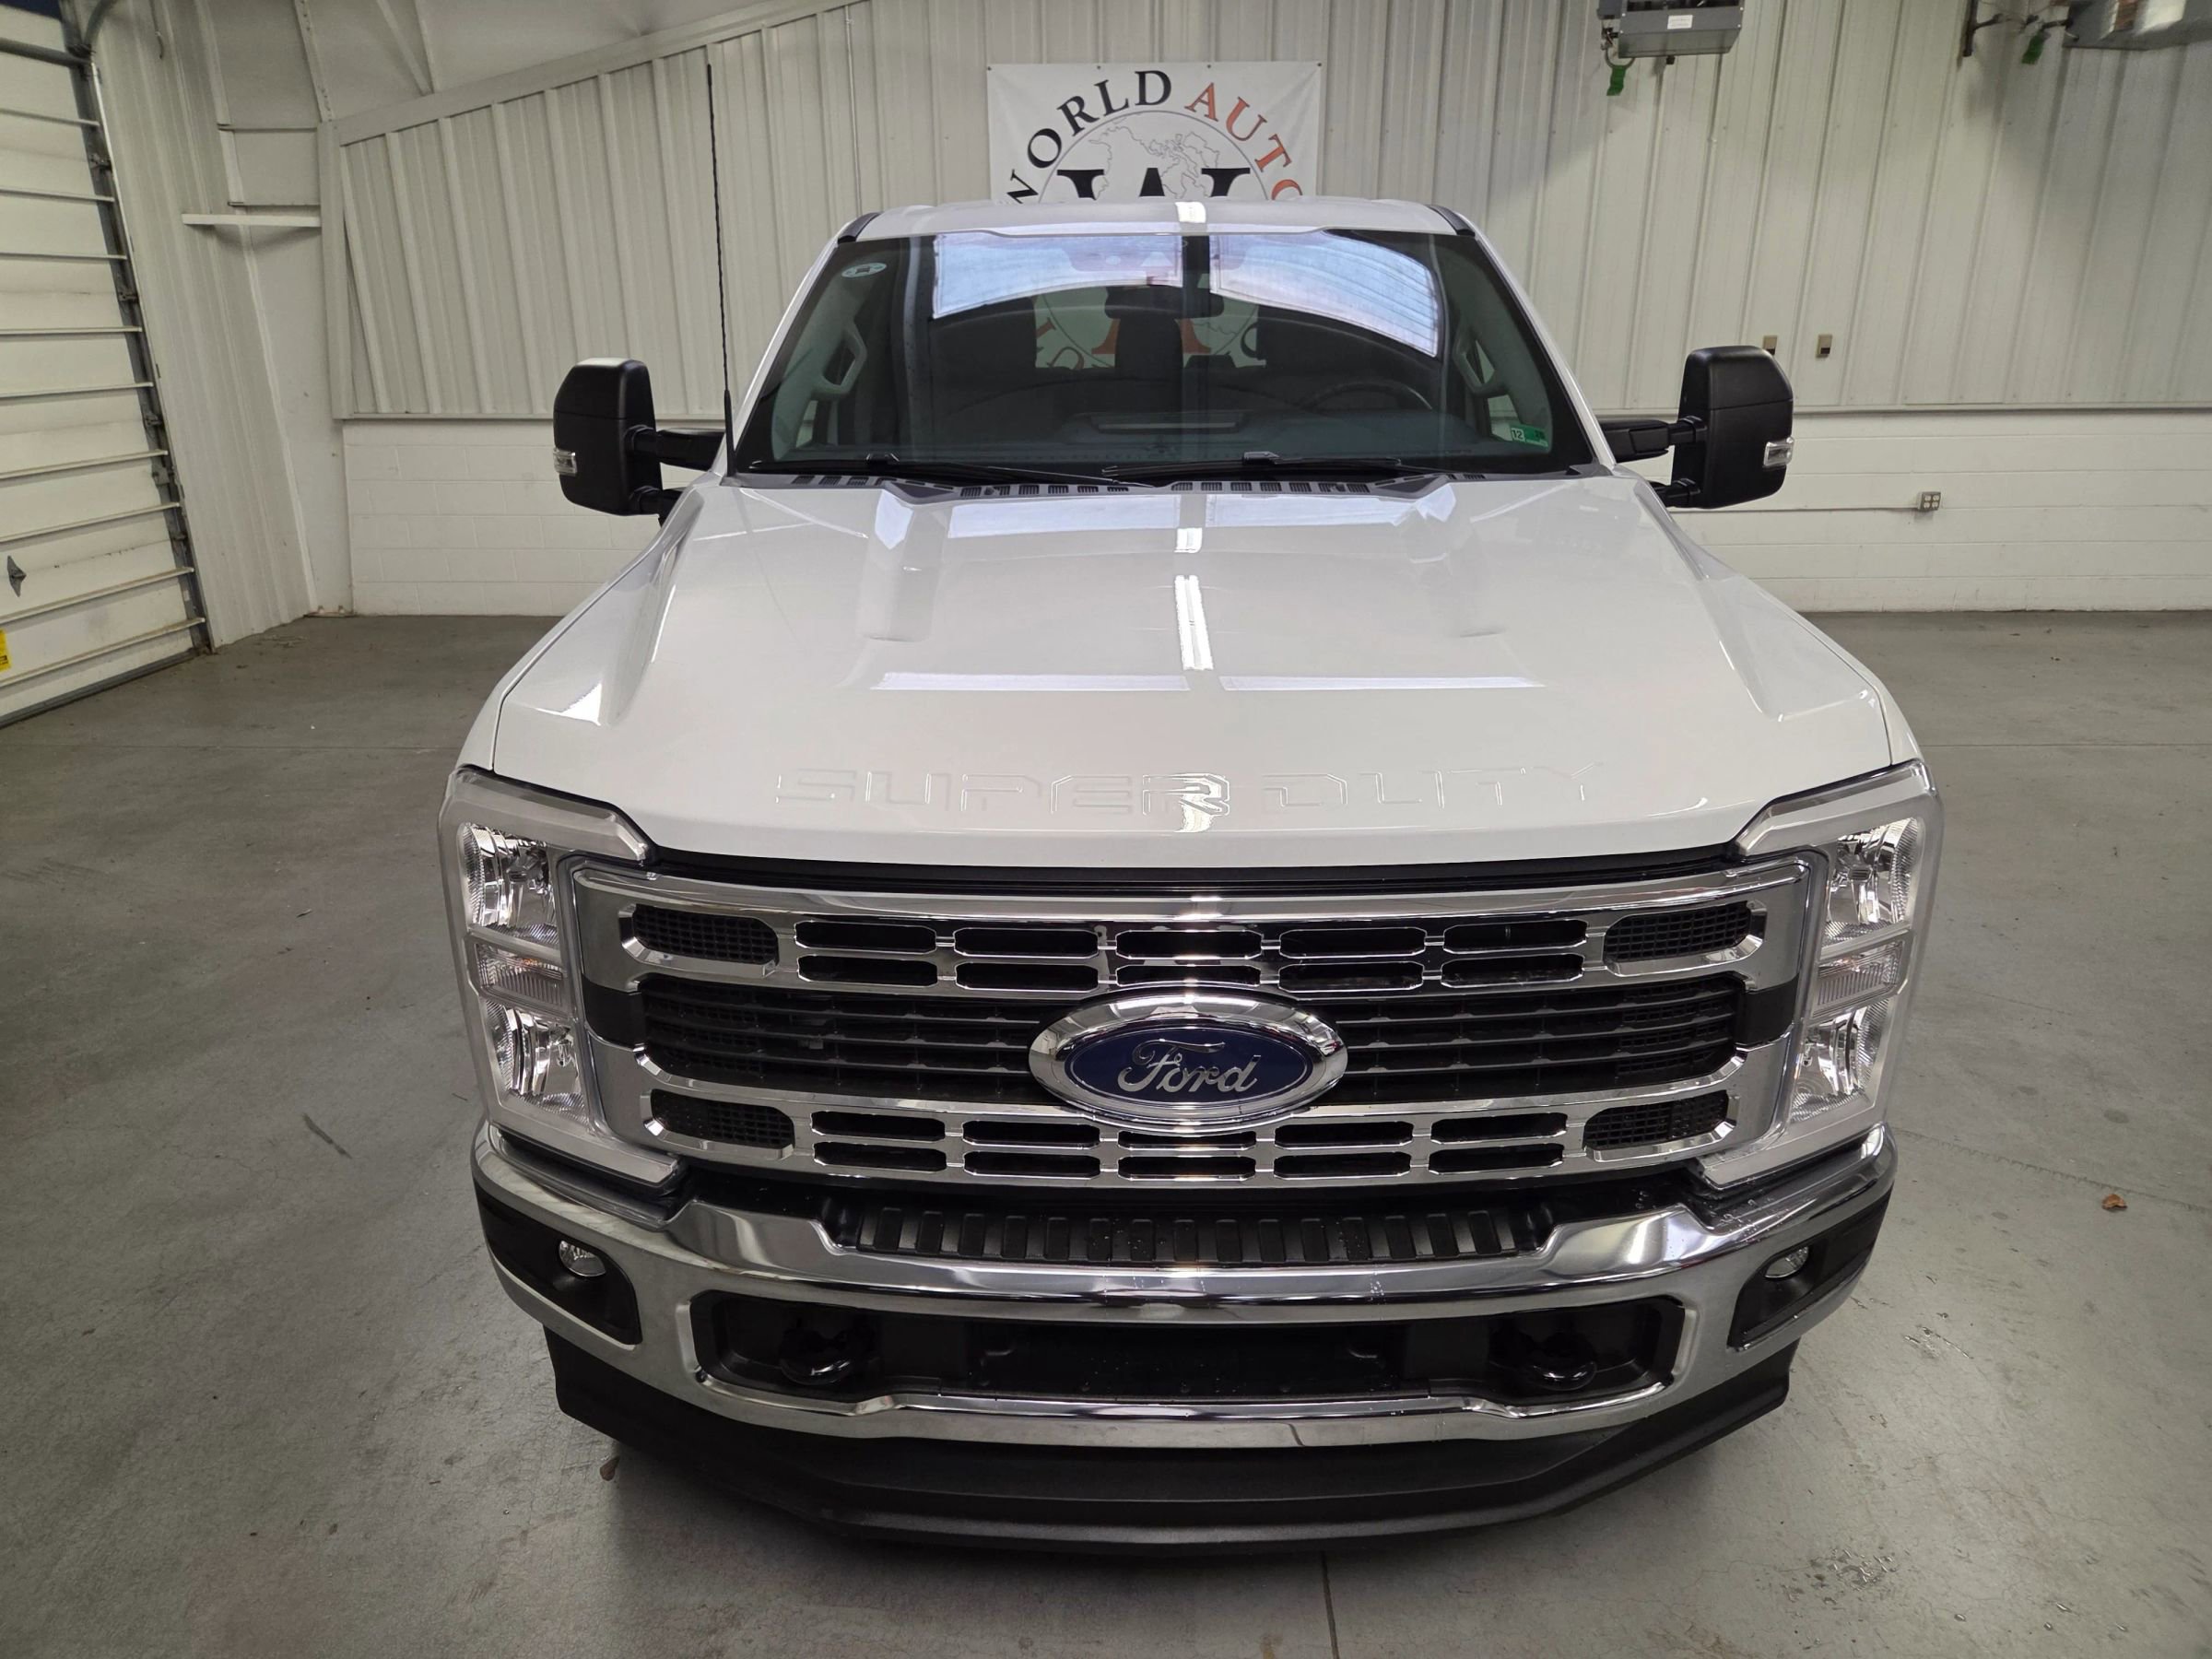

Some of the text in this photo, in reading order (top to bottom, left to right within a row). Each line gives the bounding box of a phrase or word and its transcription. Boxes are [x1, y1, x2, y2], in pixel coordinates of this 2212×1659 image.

[1512, 429, 1524, 440] 12
[775, 761, 1602, 817] SUPER DUTY
[1118, 1039, 1262, 1093] Ford
